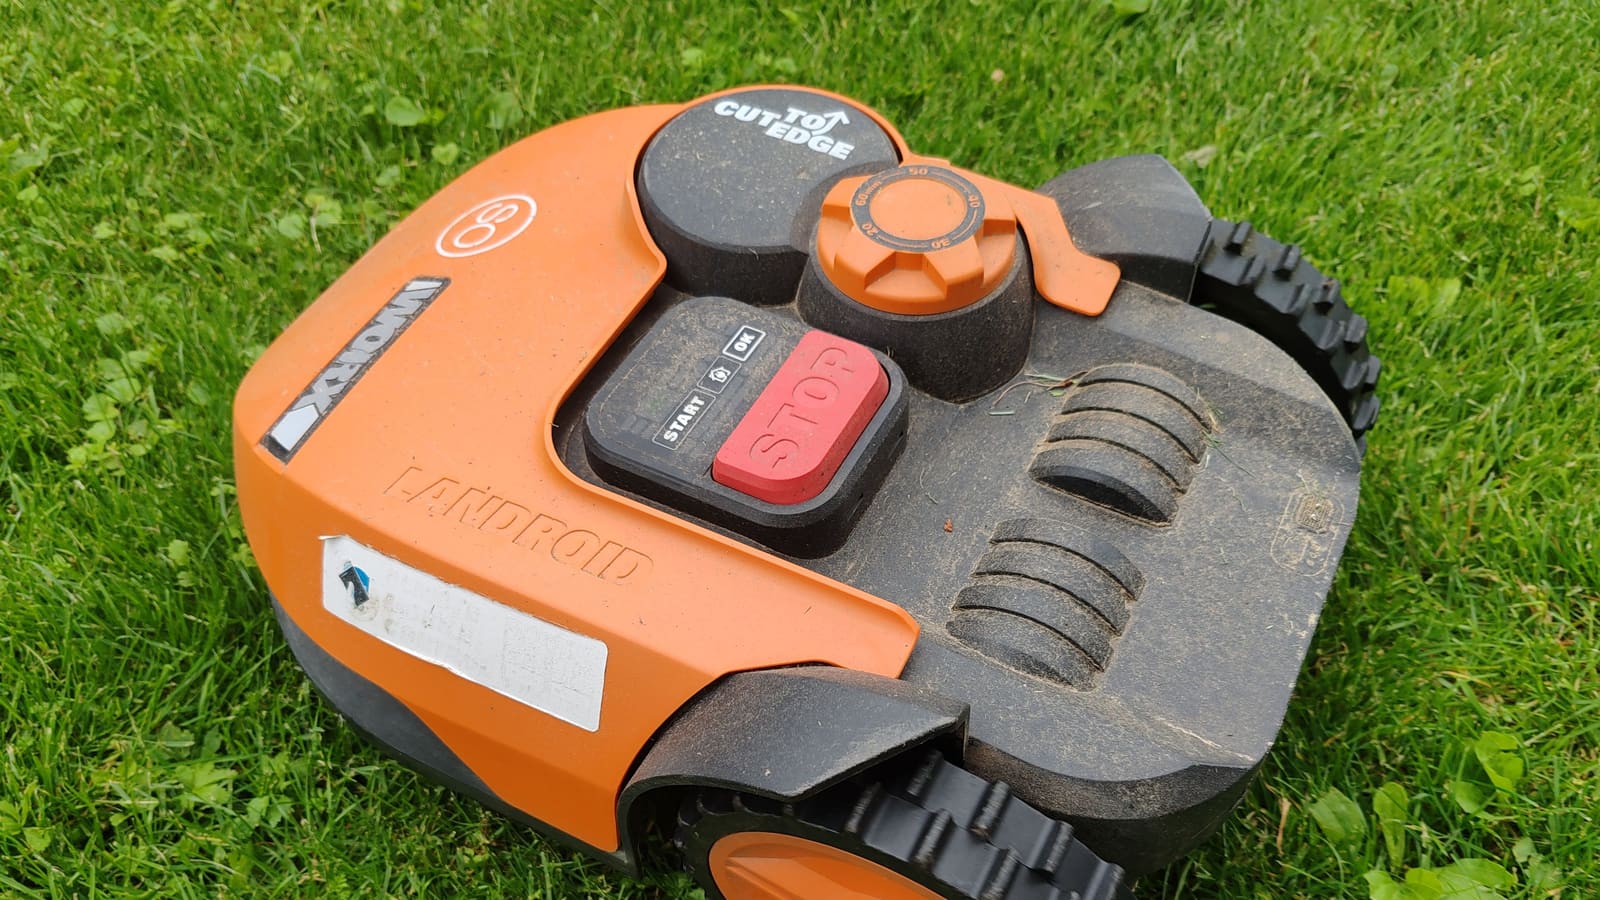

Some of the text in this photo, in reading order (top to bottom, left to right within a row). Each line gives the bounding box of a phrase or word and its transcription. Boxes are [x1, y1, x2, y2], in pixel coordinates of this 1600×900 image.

[714, 101, 782, 127] CUT
[783, 107, 827, 130] TO
[765, 121, 855, 160] EDGE
[908, 167, 928, 175] 50
[862, 223, 879, 236] 20
[289, 287, 438, 416] WORX
[733, 332, 755, 351] OK
[663, 396, 705, 442] START
[749, 347, 854, 470] STOP
[383, 466, 654, 584] LANDROID
